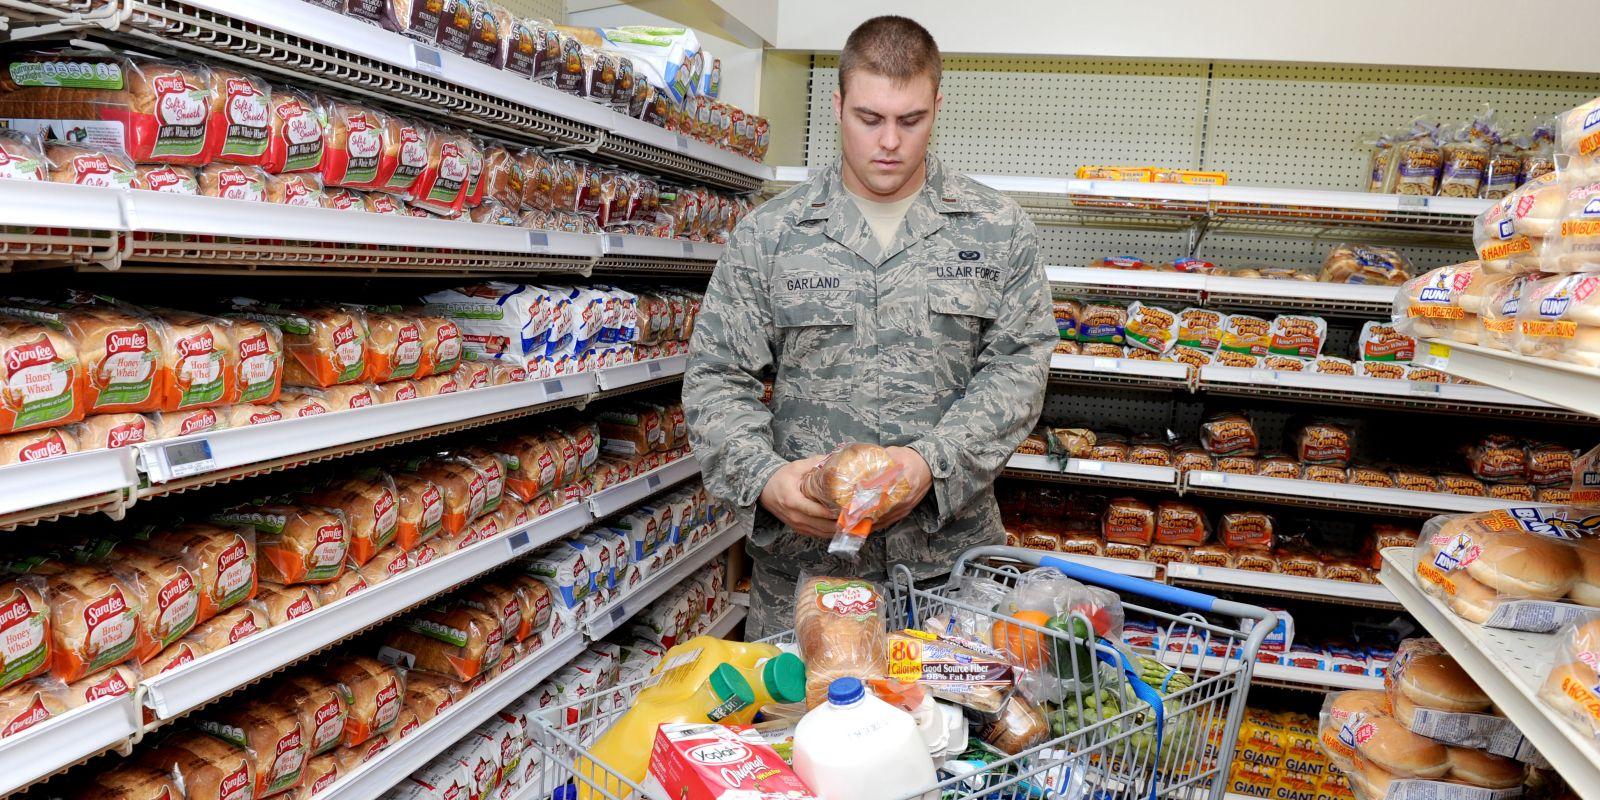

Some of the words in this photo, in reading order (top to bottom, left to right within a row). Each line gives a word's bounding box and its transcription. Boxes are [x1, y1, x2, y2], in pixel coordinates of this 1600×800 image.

[1562, 222, 1567, 236] 8
[956, 267, 972, 278] AIR
[976, 268, 1000, 282] FORCE
[787, 277, 840, 290] GARLAND
[1522, 322, 1528, 334] 8
[1556, 322, 1575, 336] BUNS
[109, 335, 132, 352] Sara
[131, 334, 146, 348] Lee
[10, 347, 38, 370] Sara
[37, 346, 54, 361] Lee
[118, 358, 140, 368] Honey
[25, 371, 52, 382] Honey
[116, 368, 138, 378] Wheat
[26, 383, 52, 395] Wheat
[161, 588, 180, 608] Sara
[178, 578, 194, 592] Lee
[88, 606, 111, 626] Sara
[109, 598, 126, 614] Lee
[6, 628, 31, 645] Honey
[8, 639, 33, 654] Wheat
[892, 640, 920, 662] 80
[892, 662, 920, 674] Calories
[922, 664, 942, 672] Good
[944, 664, 968, 672] Source
[1562, 678, 1570, 691] 8
[1568, 683, 1593, 700] HOT
[1244, 750, 1280, 767] GIANT
[720, 755, 768, 788] Original
[1286, 758, 1324, 776] GIANT
[1234, 781, 1272, 798] GIANT
